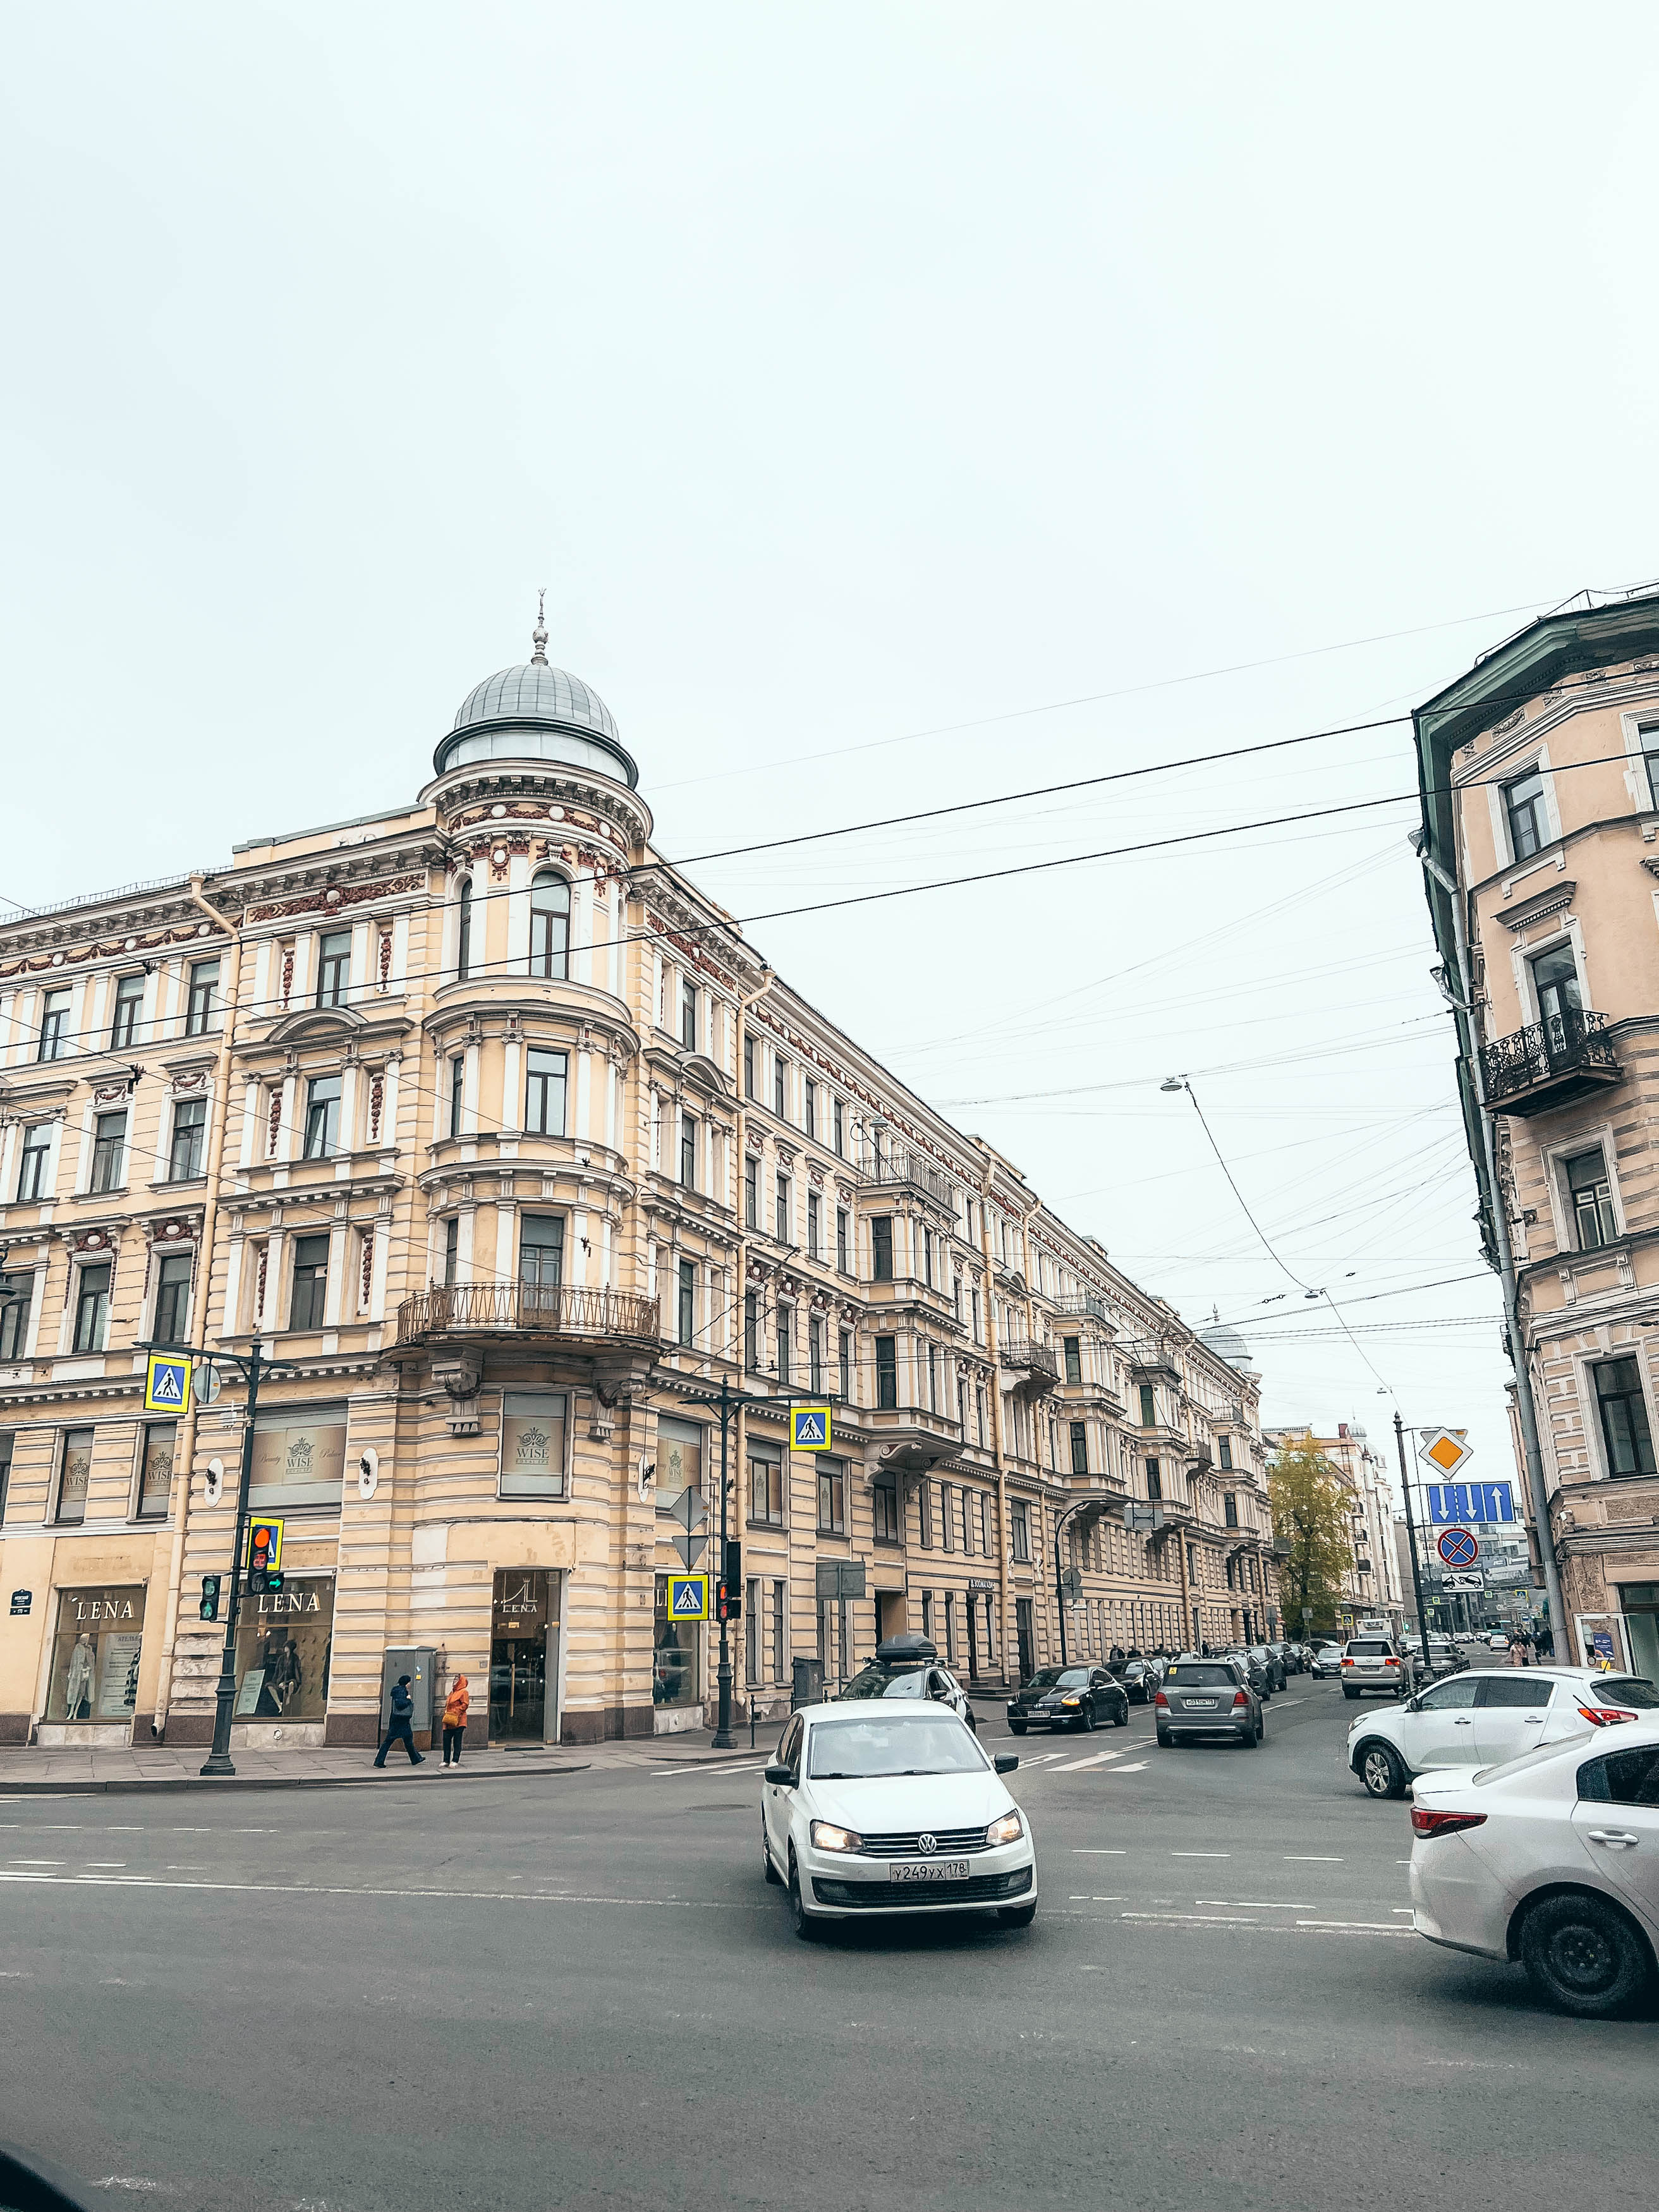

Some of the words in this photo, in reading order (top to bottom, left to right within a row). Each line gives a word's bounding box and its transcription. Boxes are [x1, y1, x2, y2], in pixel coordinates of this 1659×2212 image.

[516, 1448, 549, 1458] WISE
[287, 1457, 314, 1468] WISE
[257, 1592, 320, 1613] LENA
[502, 1603, 537, 1613] LENA
[76, 1600, 134, 1620] LENA
